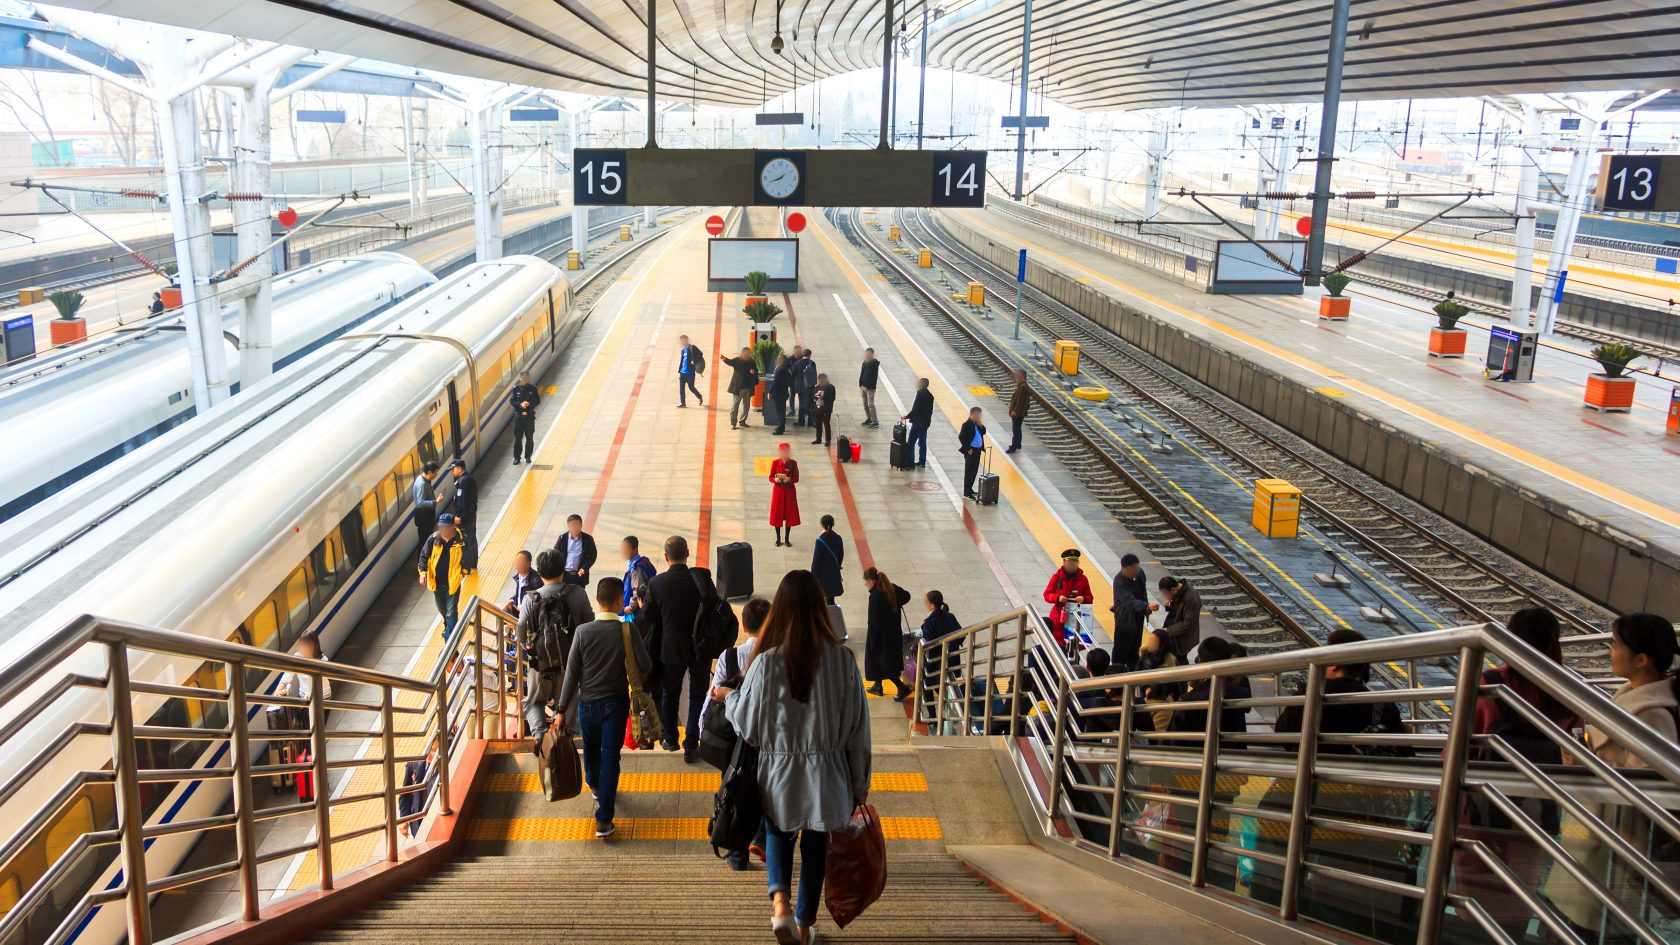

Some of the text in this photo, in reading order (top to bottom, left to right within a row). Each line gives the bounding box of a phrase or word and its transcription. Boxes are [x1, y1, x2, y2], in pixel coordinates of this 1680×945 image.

[581, 161, 621, 194] 15
[938, 163, 978, 196] 14
[1613, 167, 1653, 200] 13
